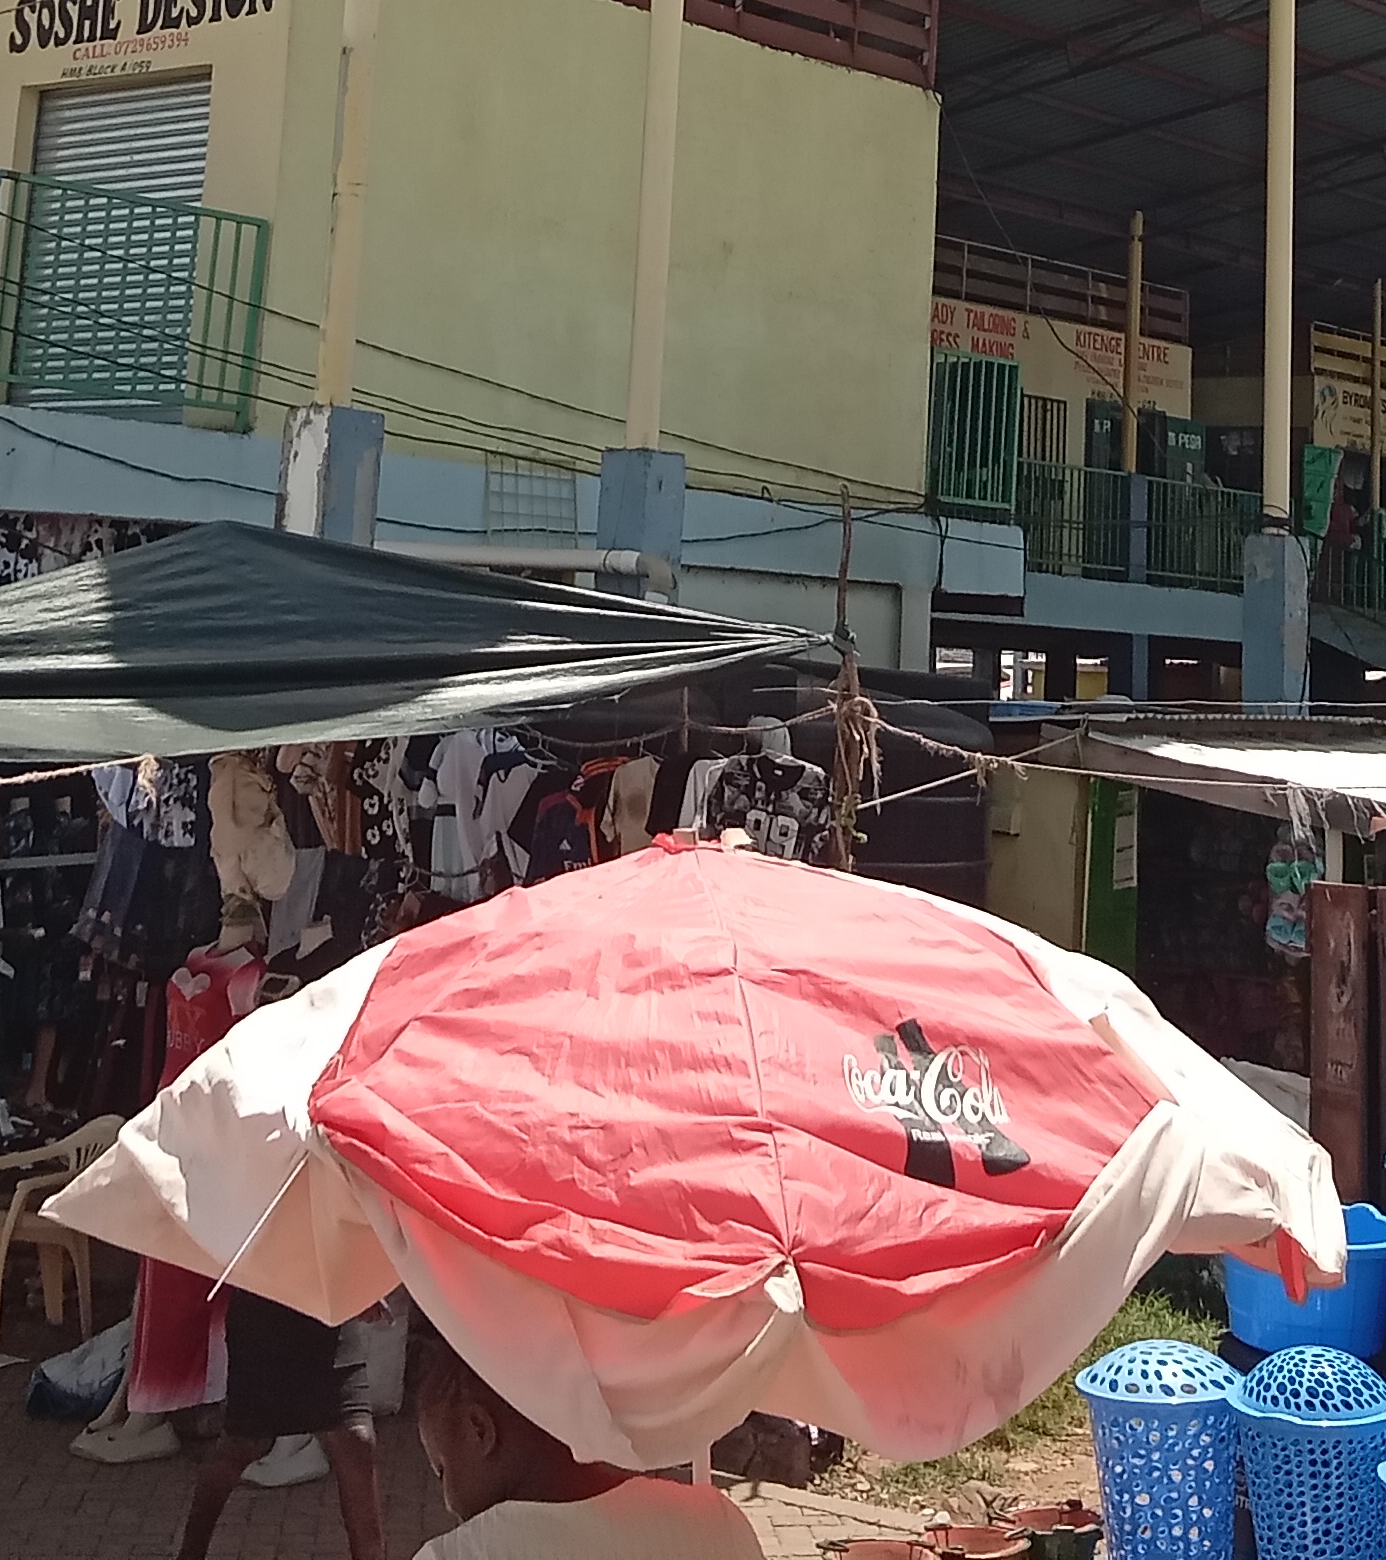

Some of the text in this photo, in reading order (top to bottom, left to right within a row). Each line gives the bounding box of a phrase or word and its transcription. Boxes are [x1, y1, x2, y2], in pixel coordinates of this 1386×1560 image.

[113, 31, 190, 56] 0729659394
[932, 302, 1030, 340] ADY TAILORING &
[931, 329, 1014, 359] RESS MAKING
[1076, 329, 1123, 355] KITENGE
[1138, 342, 1170, 365] ENTRE
[842, 1044, 1012, 1124] Coca-Cola
